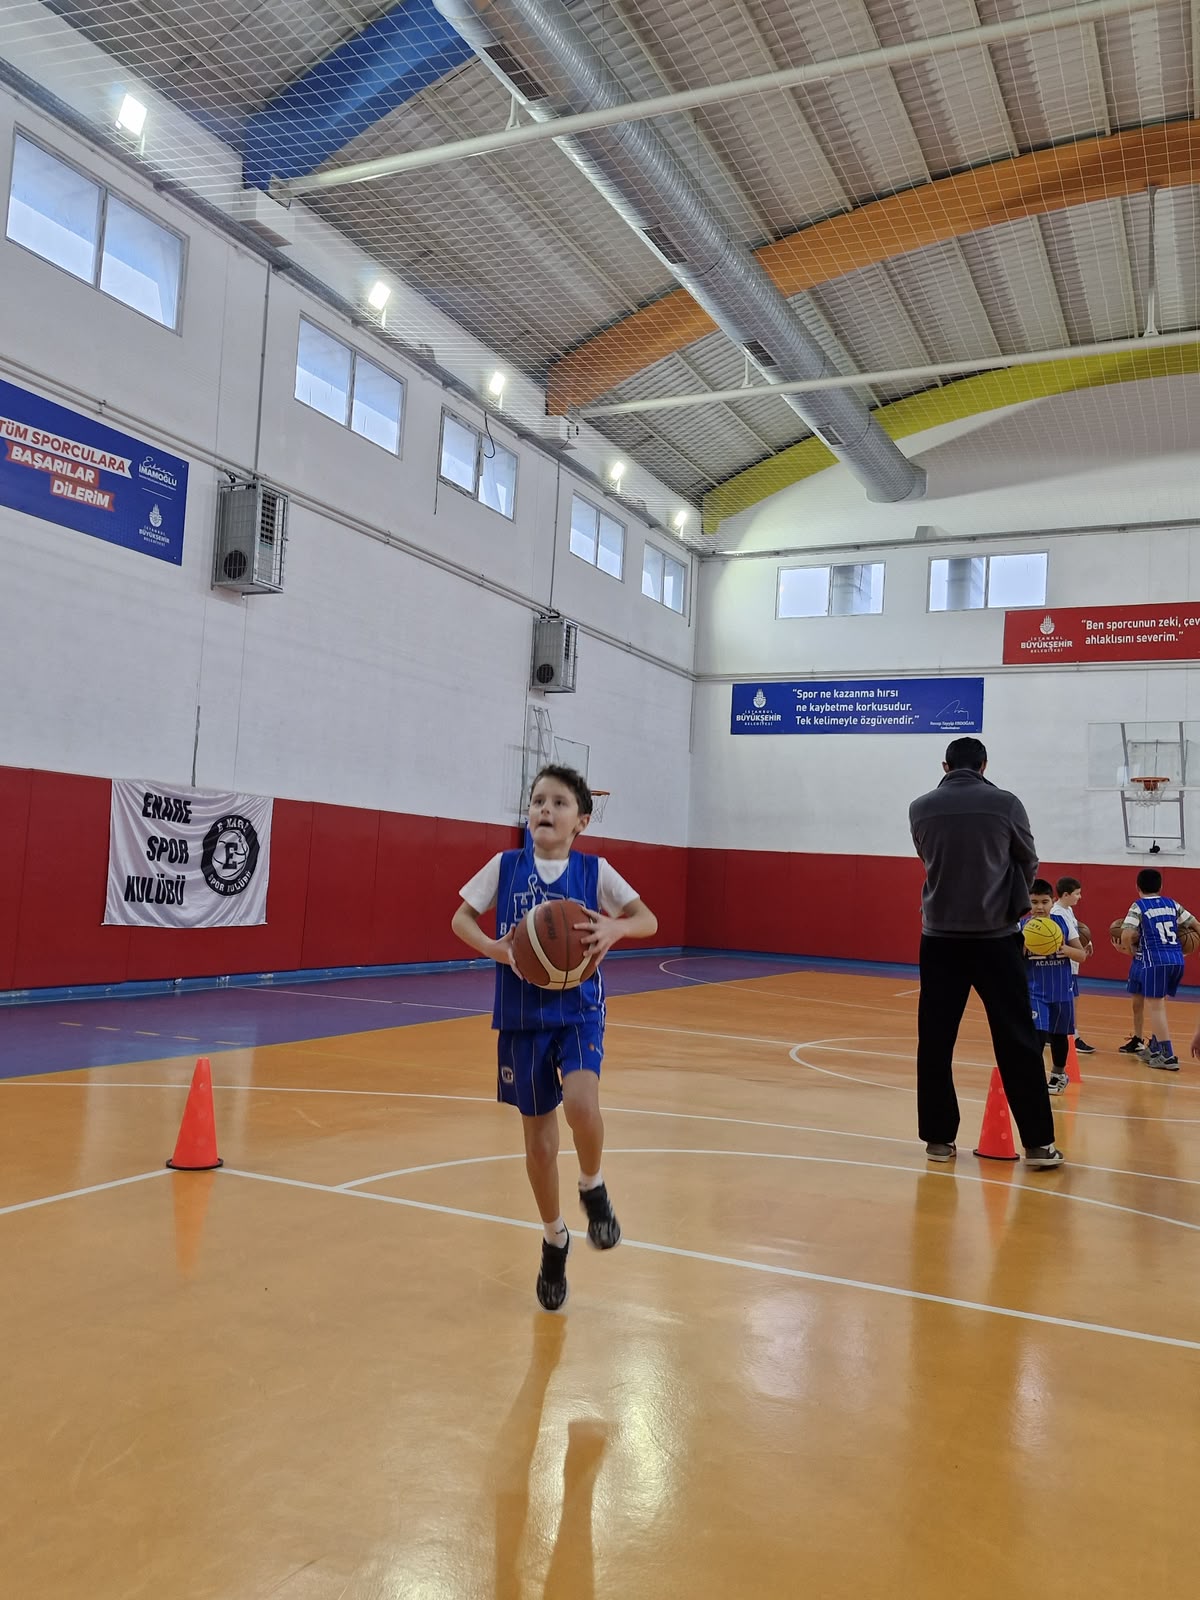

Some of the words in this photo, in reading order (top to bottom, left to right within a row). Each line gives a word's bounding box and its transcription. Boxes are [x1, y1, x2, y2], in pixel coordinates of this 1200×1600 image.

[0, 420, 28, 441] TÜM
[31, 431, 125, 473] SPORCULARA
[11, 445, 95, 484] BAŞARILAR
[138, 463, 177, 487] İMAMOĞLU
[52, 479, 110, 508] DİLERİM
[1106, 619, 1156, 631] sporcunun
[1158, 616, 1181, 628] zeki,
[1020, 639, 1073, 651] BÜYÜKŞEHİR
[1085, 633, 1134, 645] ahlaklısını
[833, 688, 875, 698] kazanma
[877, 688, 899, 698] hırsı
[809, 702, 854, 713] kaybetme
[856, 701, 913, 711] korkusudur.
[736, 712, 782, 722] BÜYÜKŞEHİR
[795, 715, 811, 725] Tek
[813, 715, 858, 727] kelimeyle
[142, 792, 193, 824] ENARE
[146, 835, 190, 864] SPOR
[1155, 920, 1178, 945] 15
